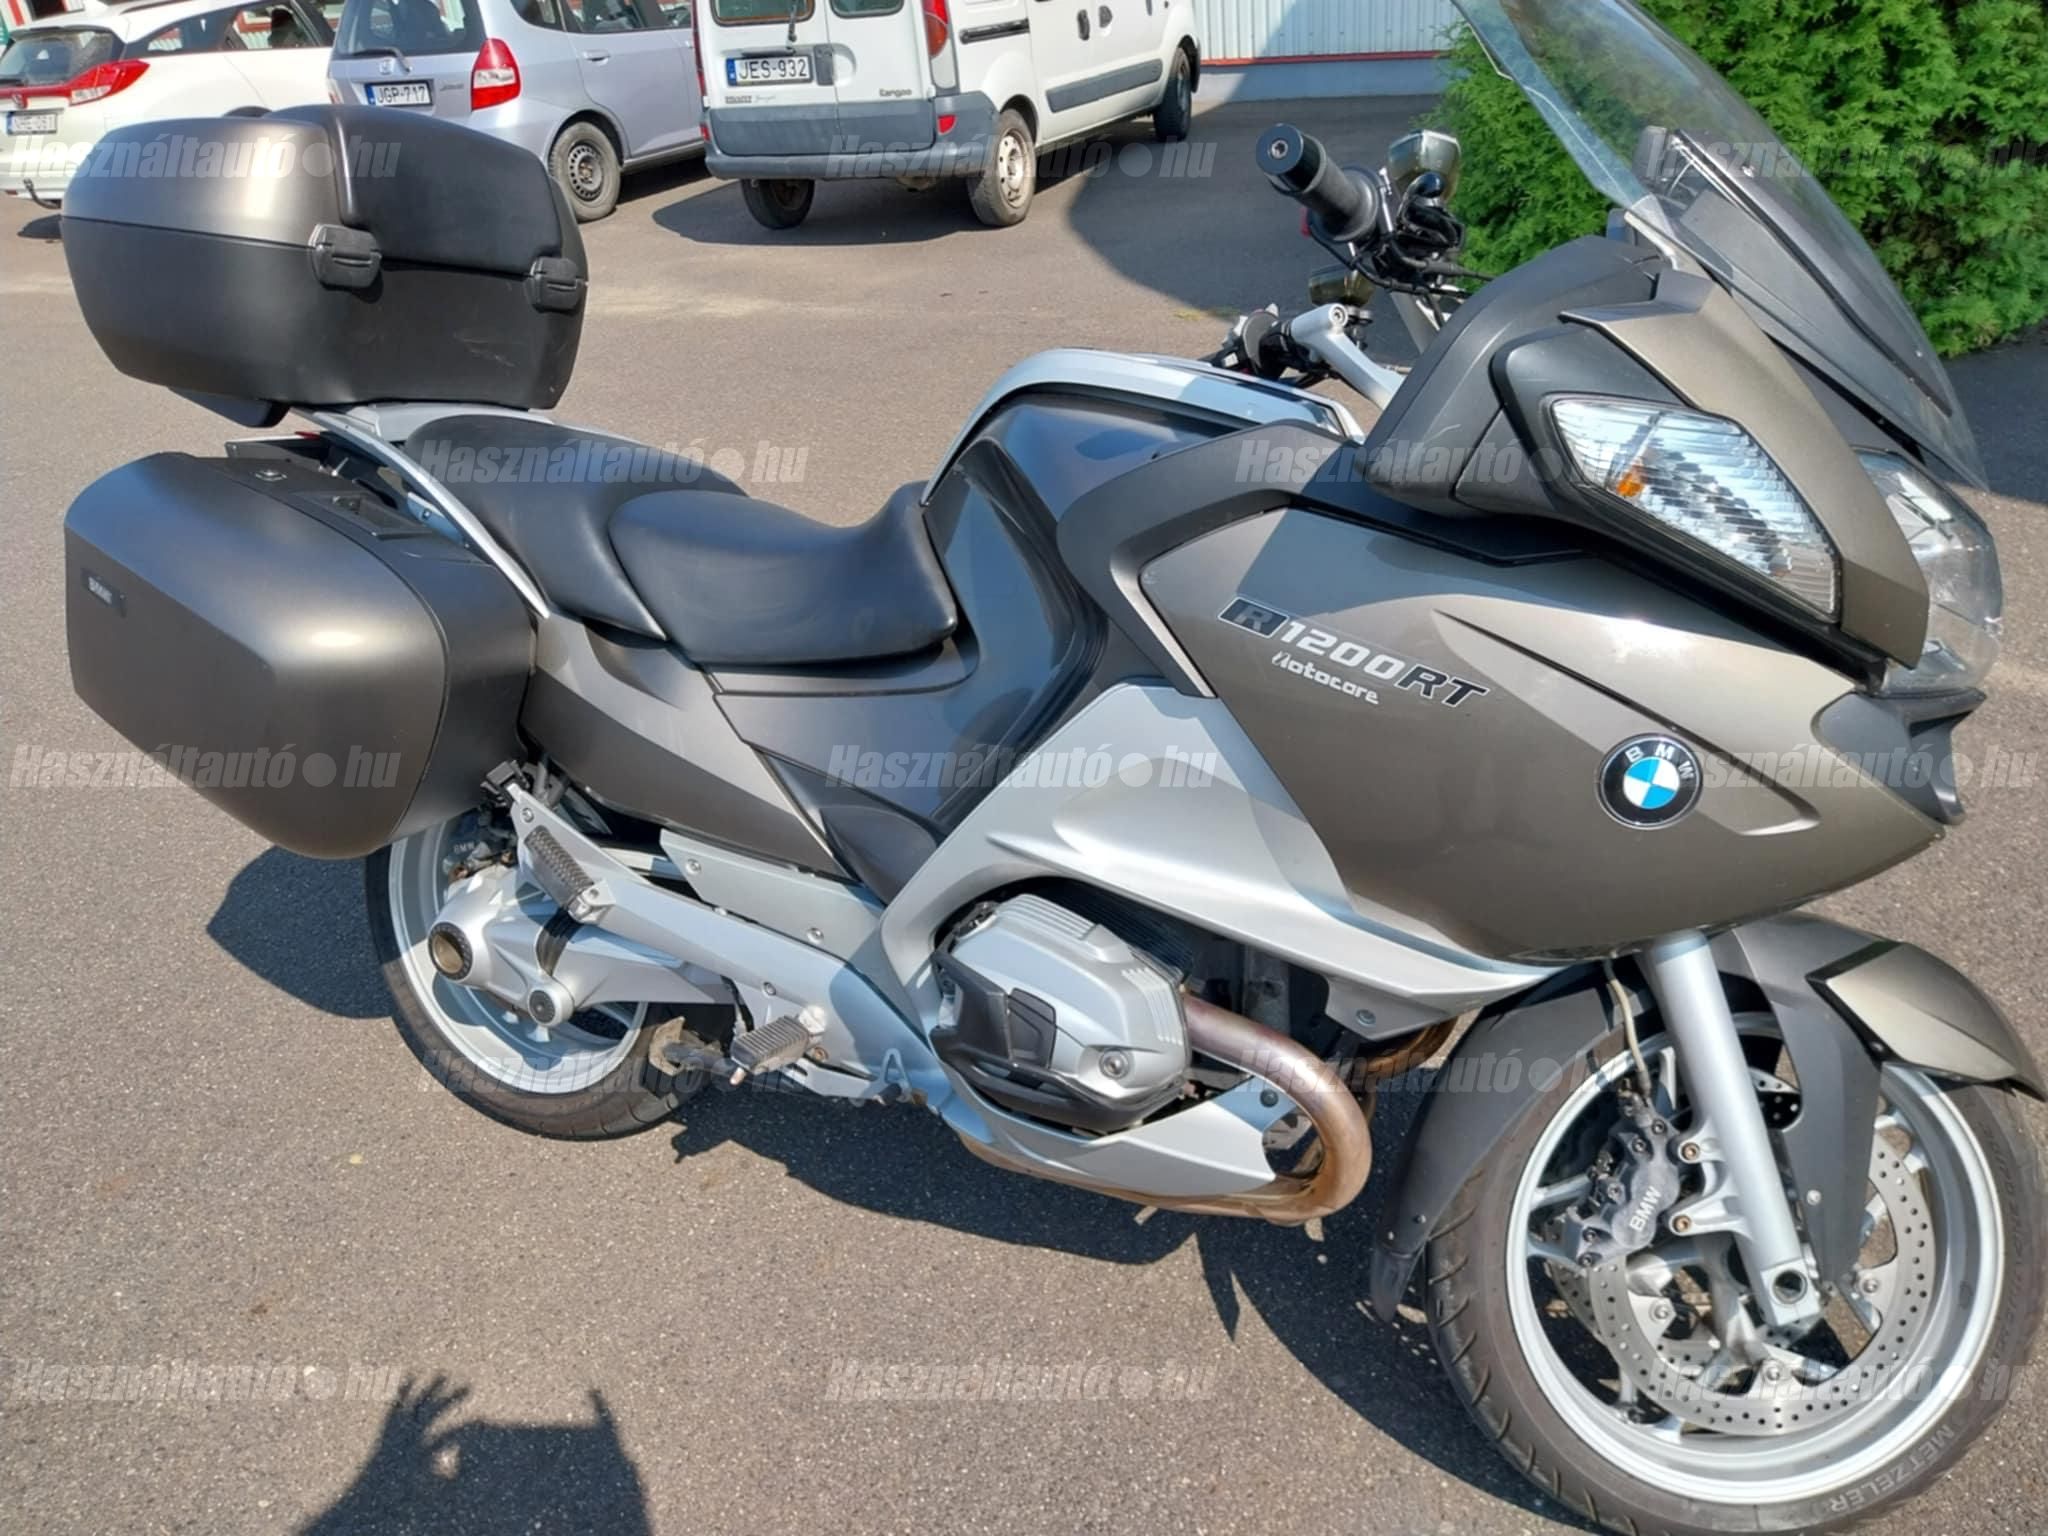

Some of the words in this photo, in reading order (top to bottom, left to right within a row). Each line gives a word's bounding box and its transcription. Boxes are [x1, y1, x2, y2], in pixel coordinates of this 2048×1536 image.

[739, 58, 807, 80] JES-932
[378, 86, 426, 104] JGP-717
[1625, 743, 1695, 780] BMW
[1629, 1185, 1661, 1232] BMW
[1830, 1426, 1955, 1513] METZELER
